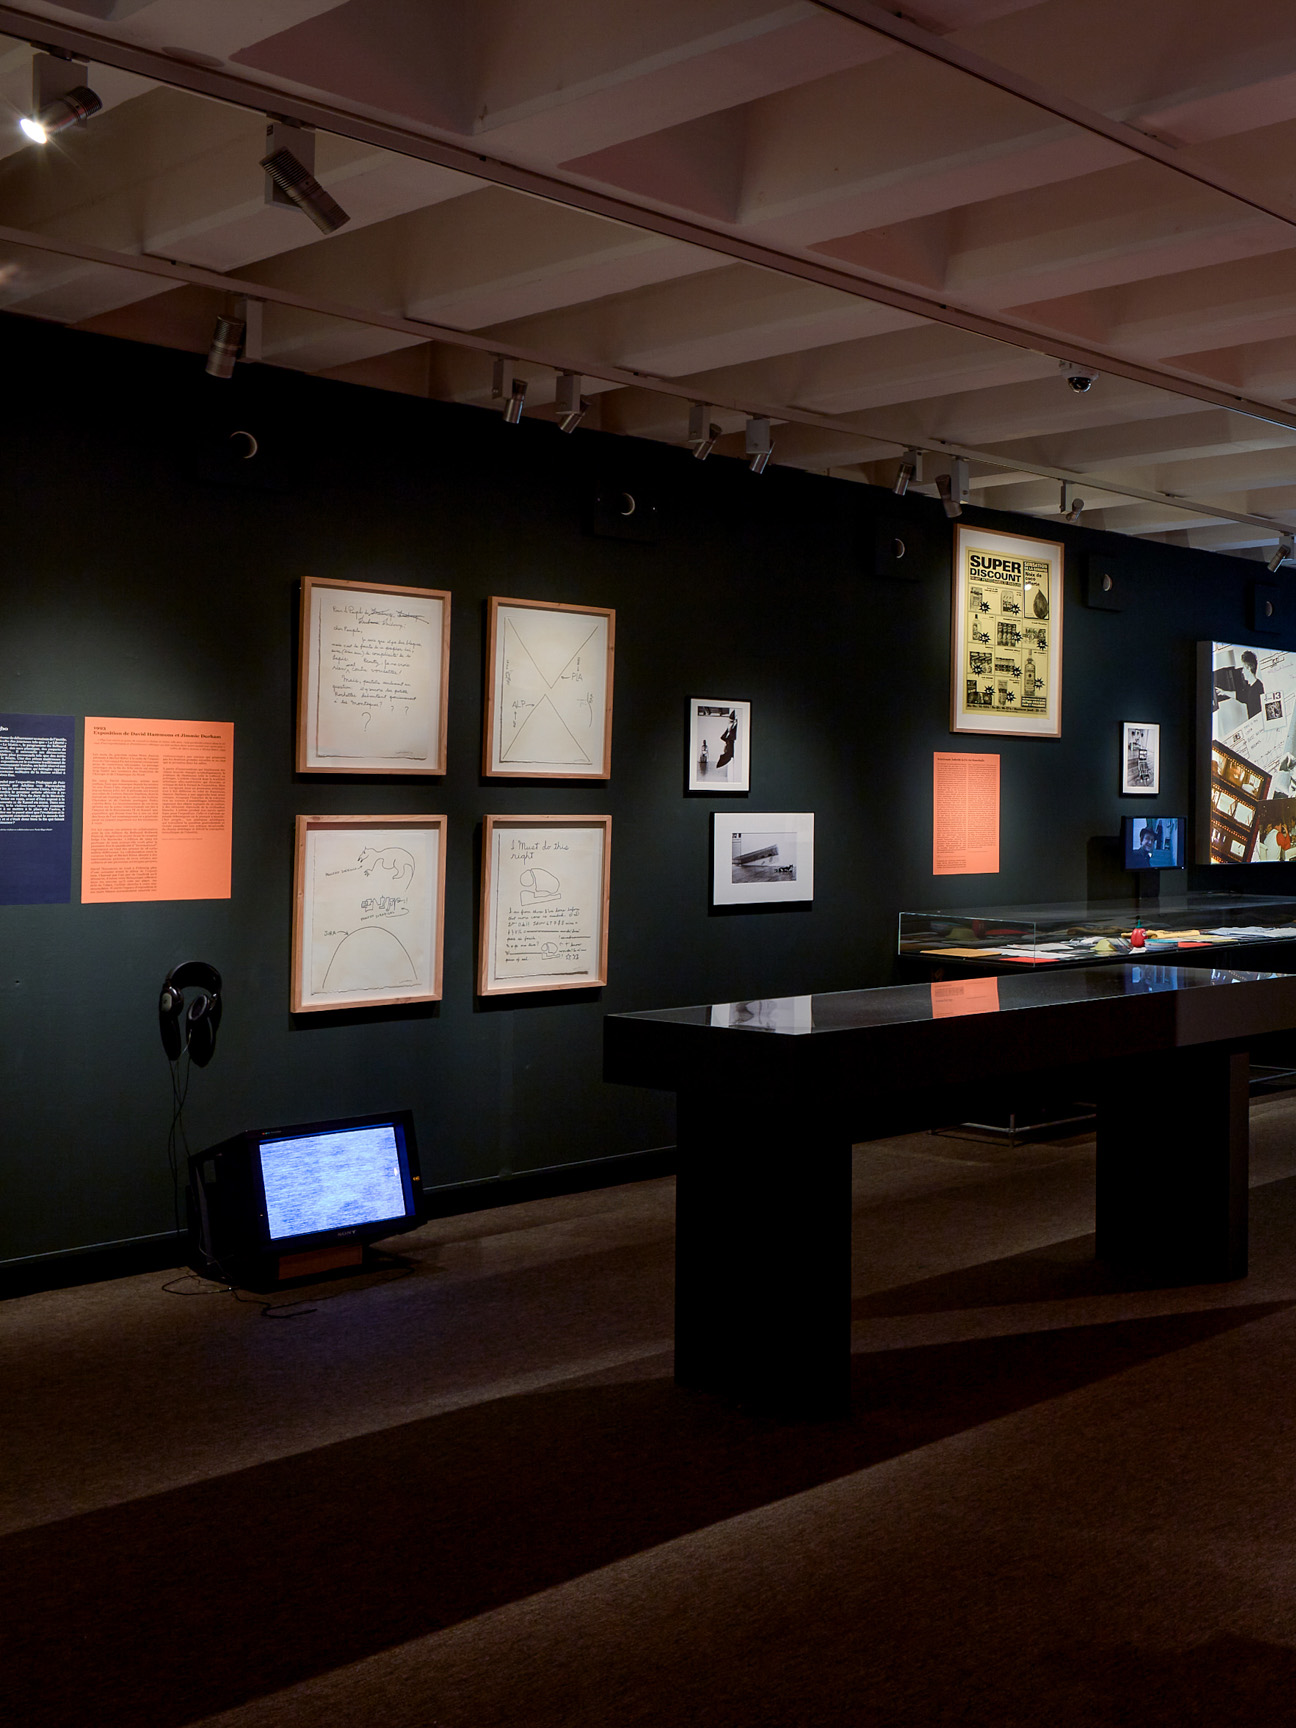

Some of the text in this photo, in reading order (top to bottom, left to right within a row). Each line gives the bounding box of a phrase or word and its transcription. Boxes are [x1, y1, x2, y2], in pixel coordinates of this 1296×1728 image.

[970, 554, 1022, 574] SUPER
[970, 568, 1022, 582] DISCOUNT
[518, 840, 539, 850] Must
[542, 840, 552, 850] do
[554, 841, 569, 850] this
[511, 852, 534, 865] right
